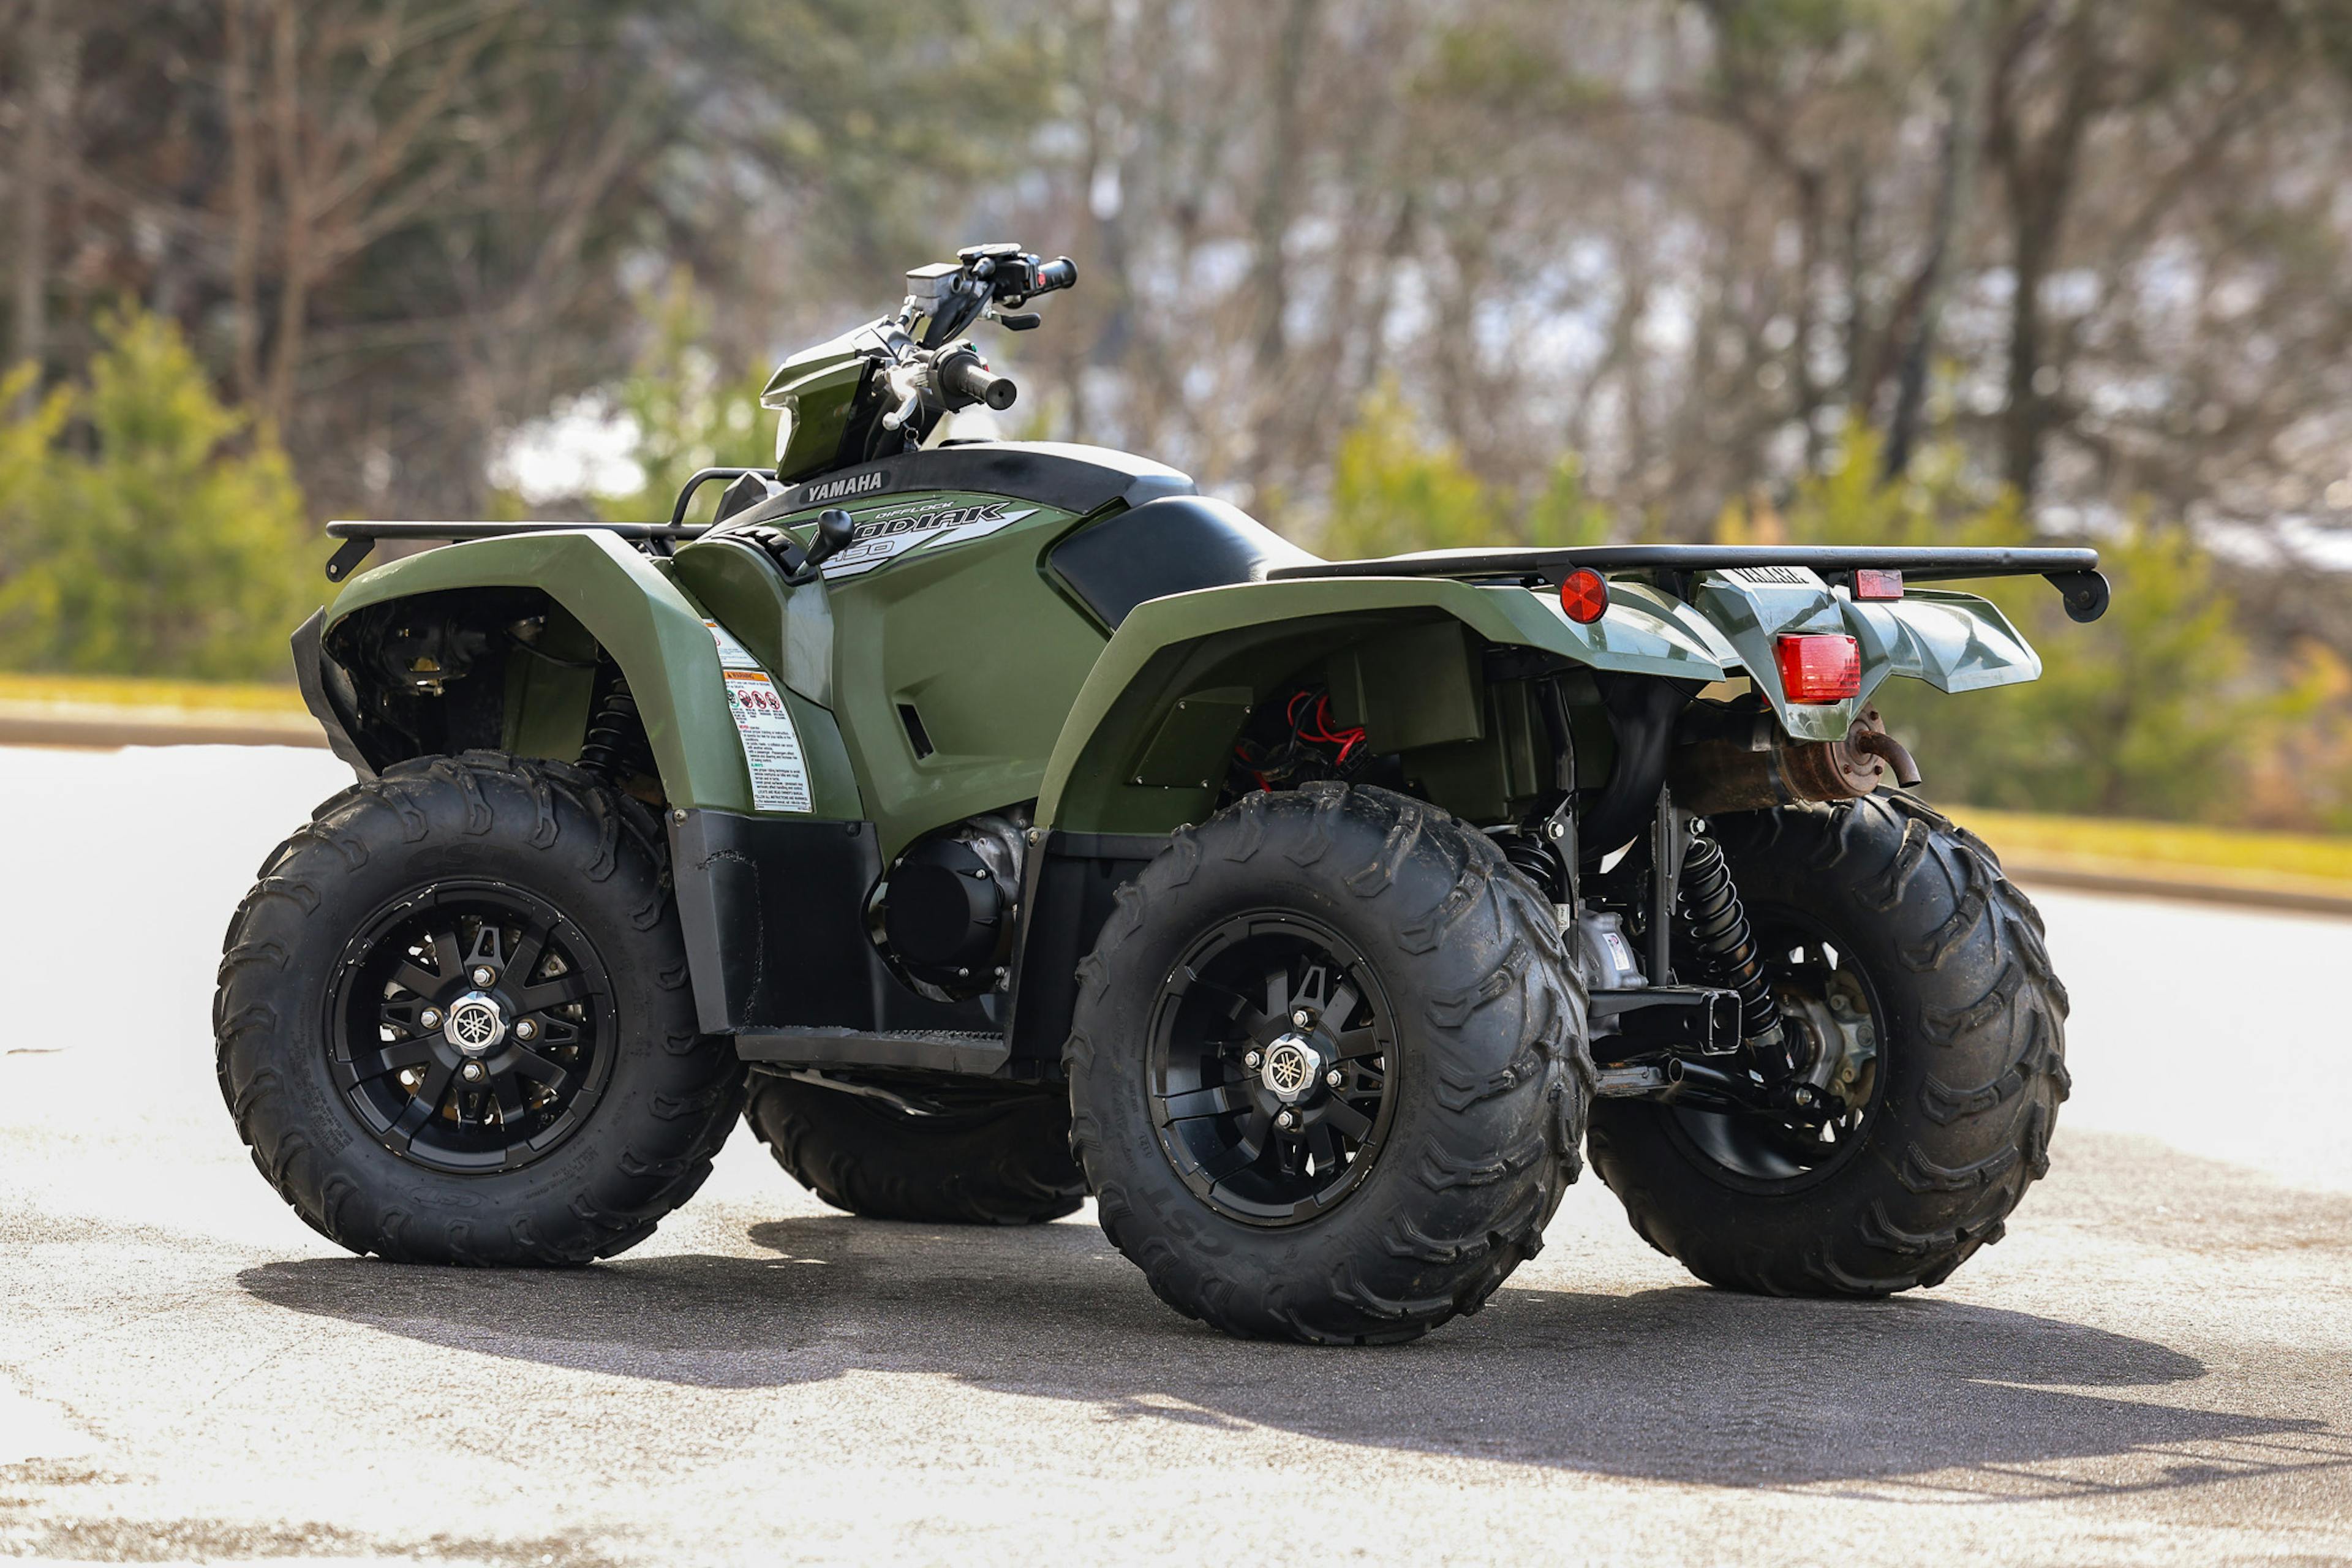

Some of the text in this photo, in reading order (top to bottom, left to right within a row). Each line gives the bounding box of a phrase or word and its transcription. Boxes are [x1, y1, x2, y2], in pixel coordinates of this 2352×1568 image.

[809, 472, 881, 502] YAMAHA
[809, 502, 1011, 547] ODIAK
[875, 502, 955, 519] DIFFLOCK
[1731, 567, 1810, 584] YAMAHA
[1137, 1186, 1235, 1256] CST
